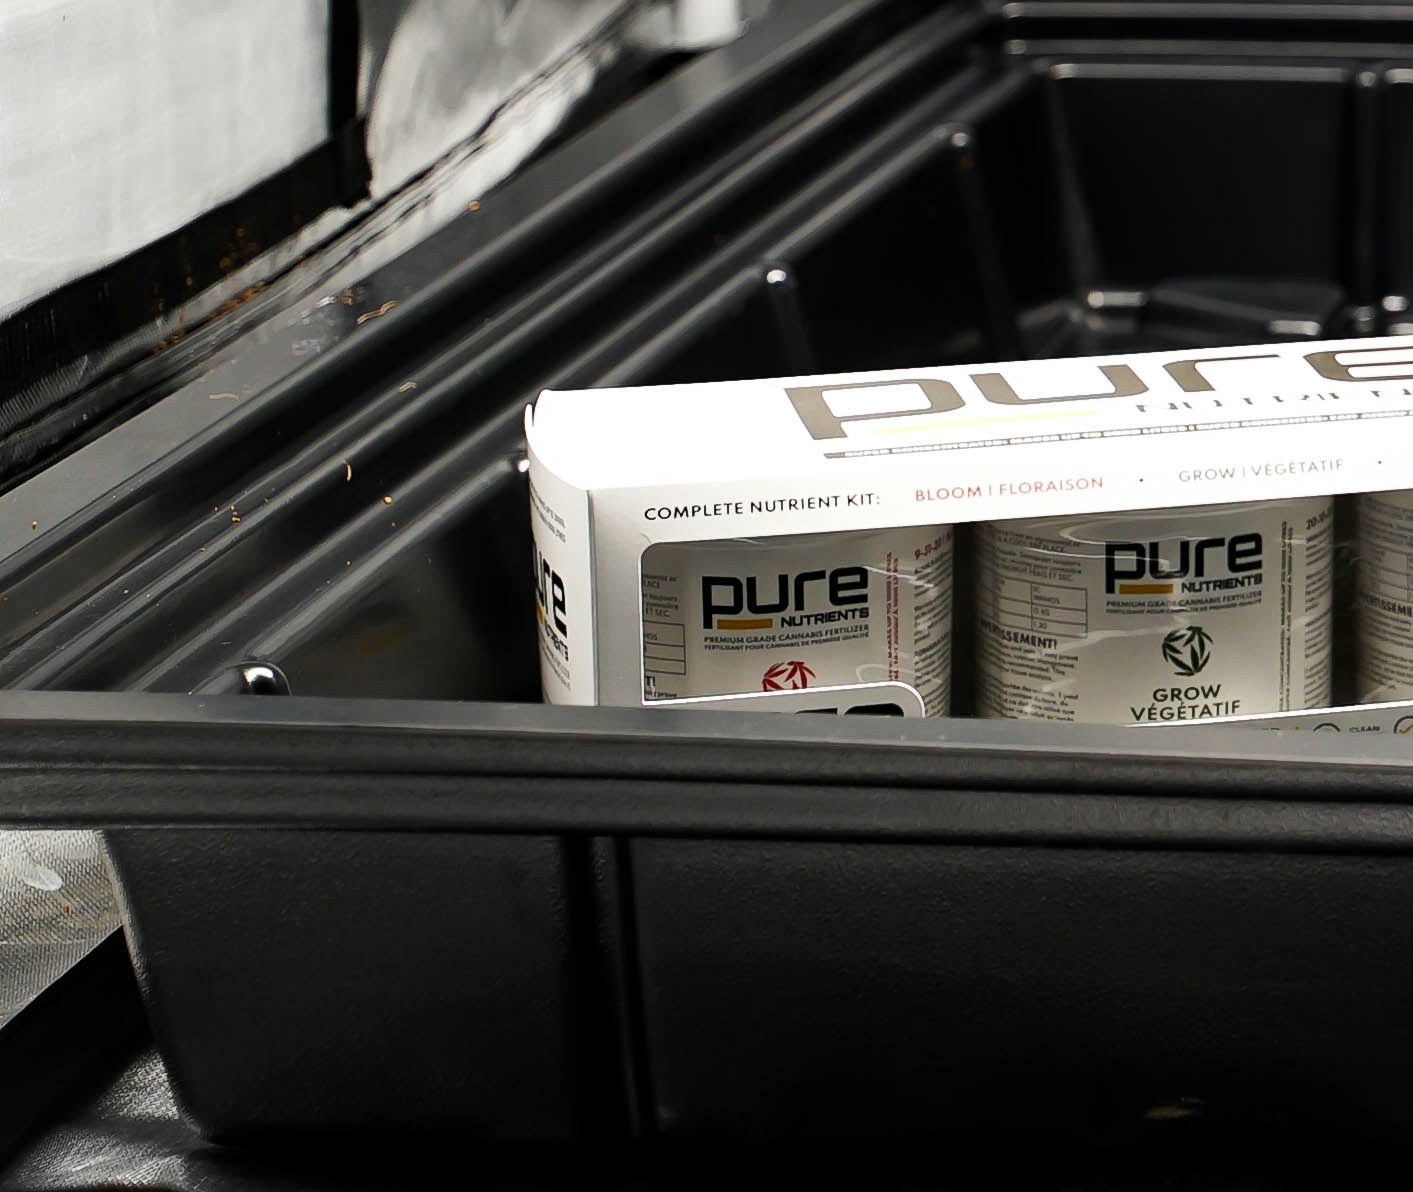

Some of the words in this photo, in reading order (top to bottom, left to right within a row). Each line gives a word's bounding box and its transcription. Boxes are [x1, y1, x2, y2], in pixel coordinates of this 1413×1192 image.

[1178, 465, 1236, 483] GROW
[915, 485, 982, 502] BLOOM
[999, 477, 1104, 496] FLORAISON
[644, 501, 744, 521] COMPLETE
[750, 495, 841, 513] NUTRIENT
[847, 492, 881, 506] KIT:
[1105, 532, 1262, 594] pure
[1181, 572, 1262, 593] NUTRIENTS
[702, 566, 869, 630] pure
[780, 607, 869, 629] NUTRIENTS
[704, 636, 744, 644] PREMIUM
[746, 634, 777, 643] GRADE
[779, 630, 823, 642] CANNABIS
[824, 623, 869, 637] FERTILIZER
[1152, 684, 1222, 702] GROW
[1130, 699, 1241, 721] VÉGÉTATIF
